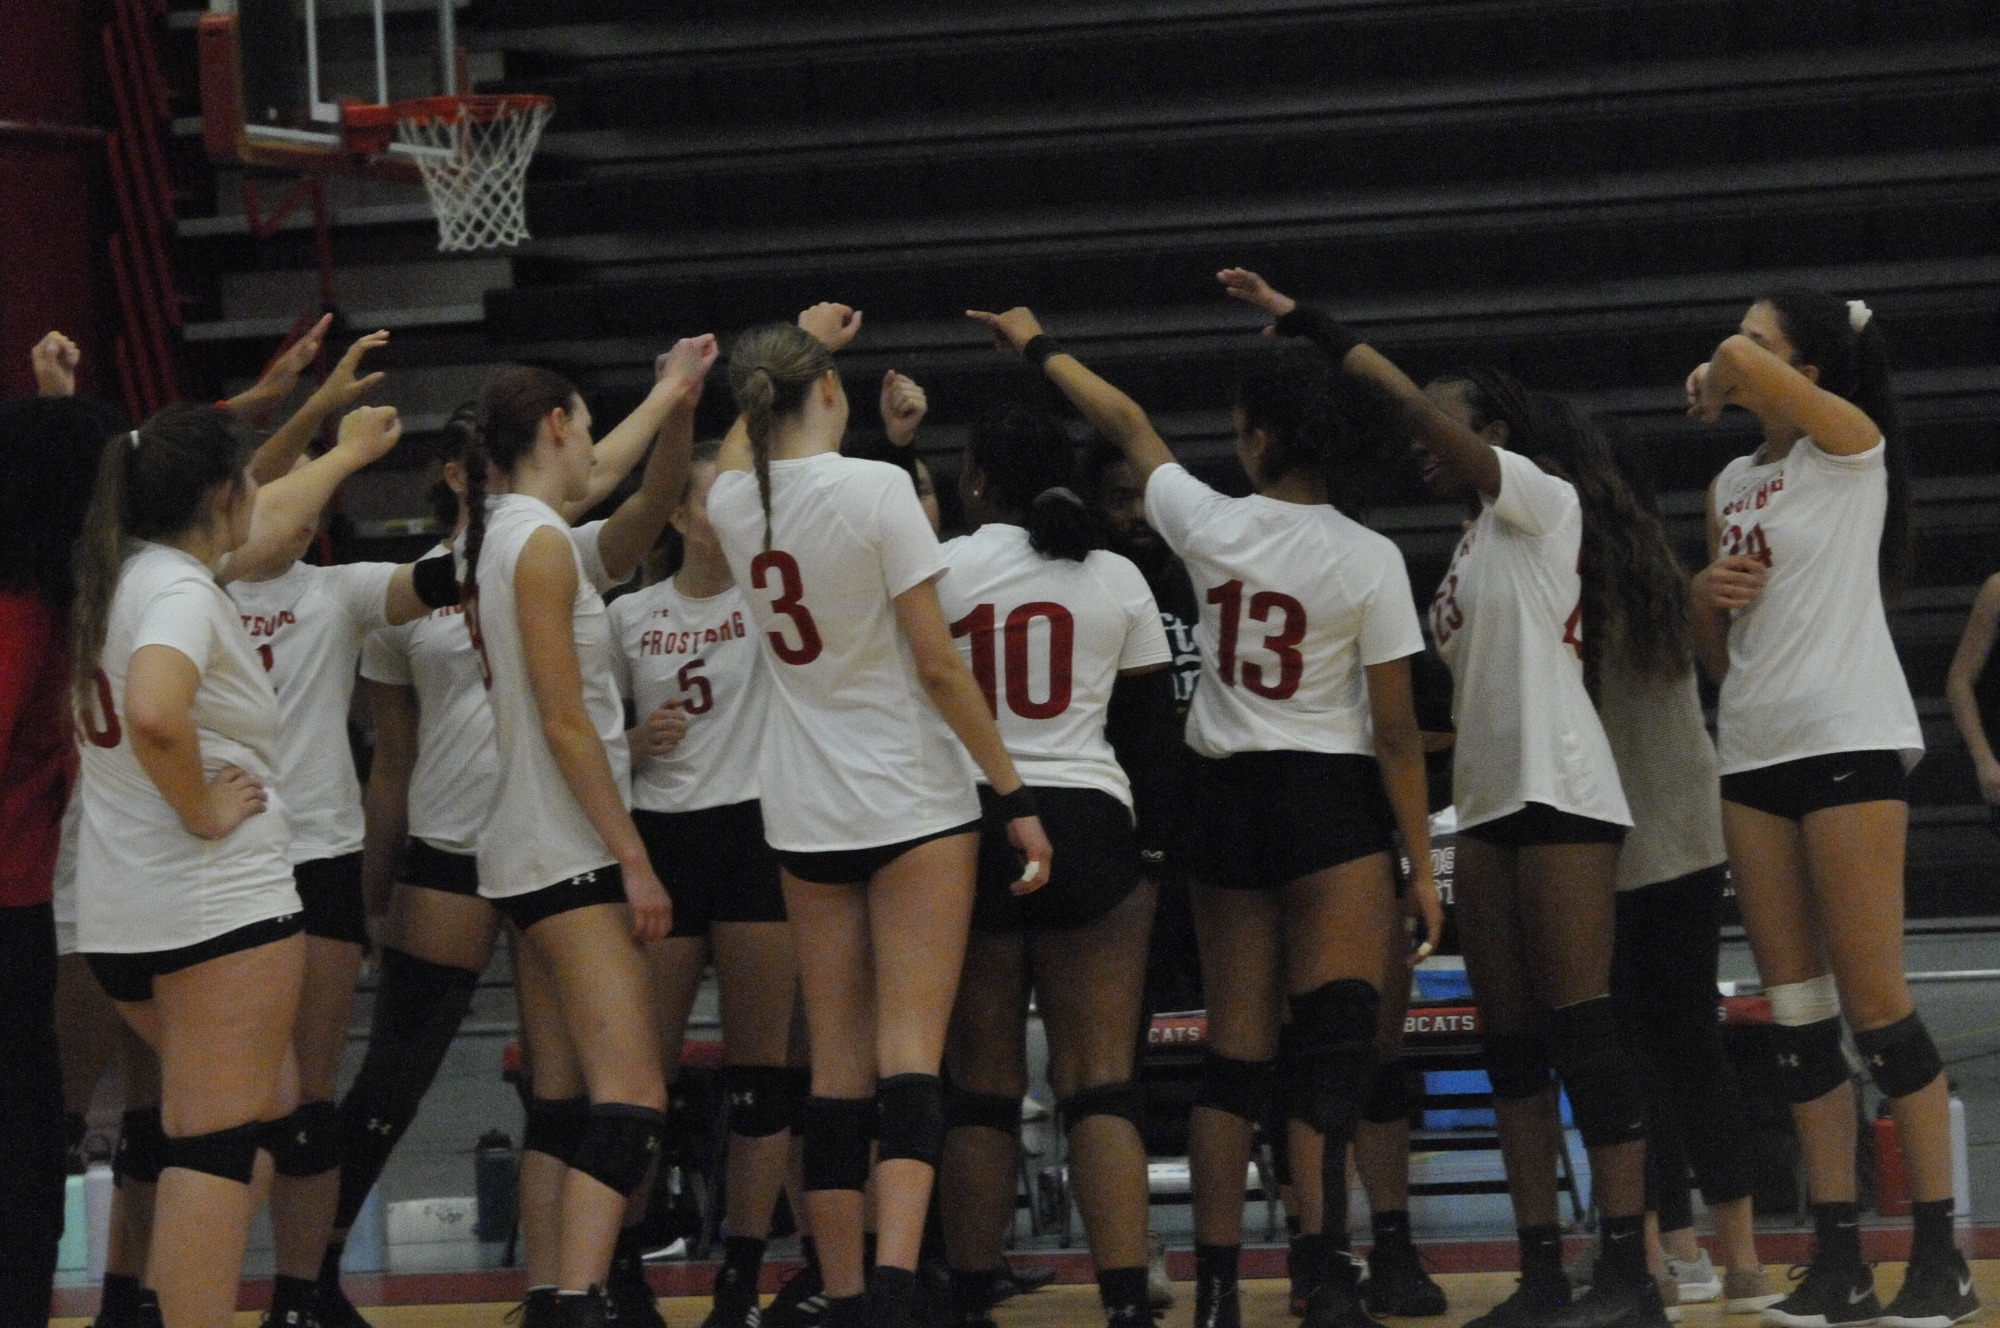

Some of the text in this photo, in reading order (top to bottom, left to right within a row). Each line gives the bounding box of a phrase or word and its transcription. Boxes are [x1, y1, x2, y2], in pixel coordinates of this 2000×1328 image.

[751, 551, 823, 665] 3
[951, 601, 1074, 720] 10
[1207, 579, 1307, 700] 13
[678, 659, 713, 715] 5
